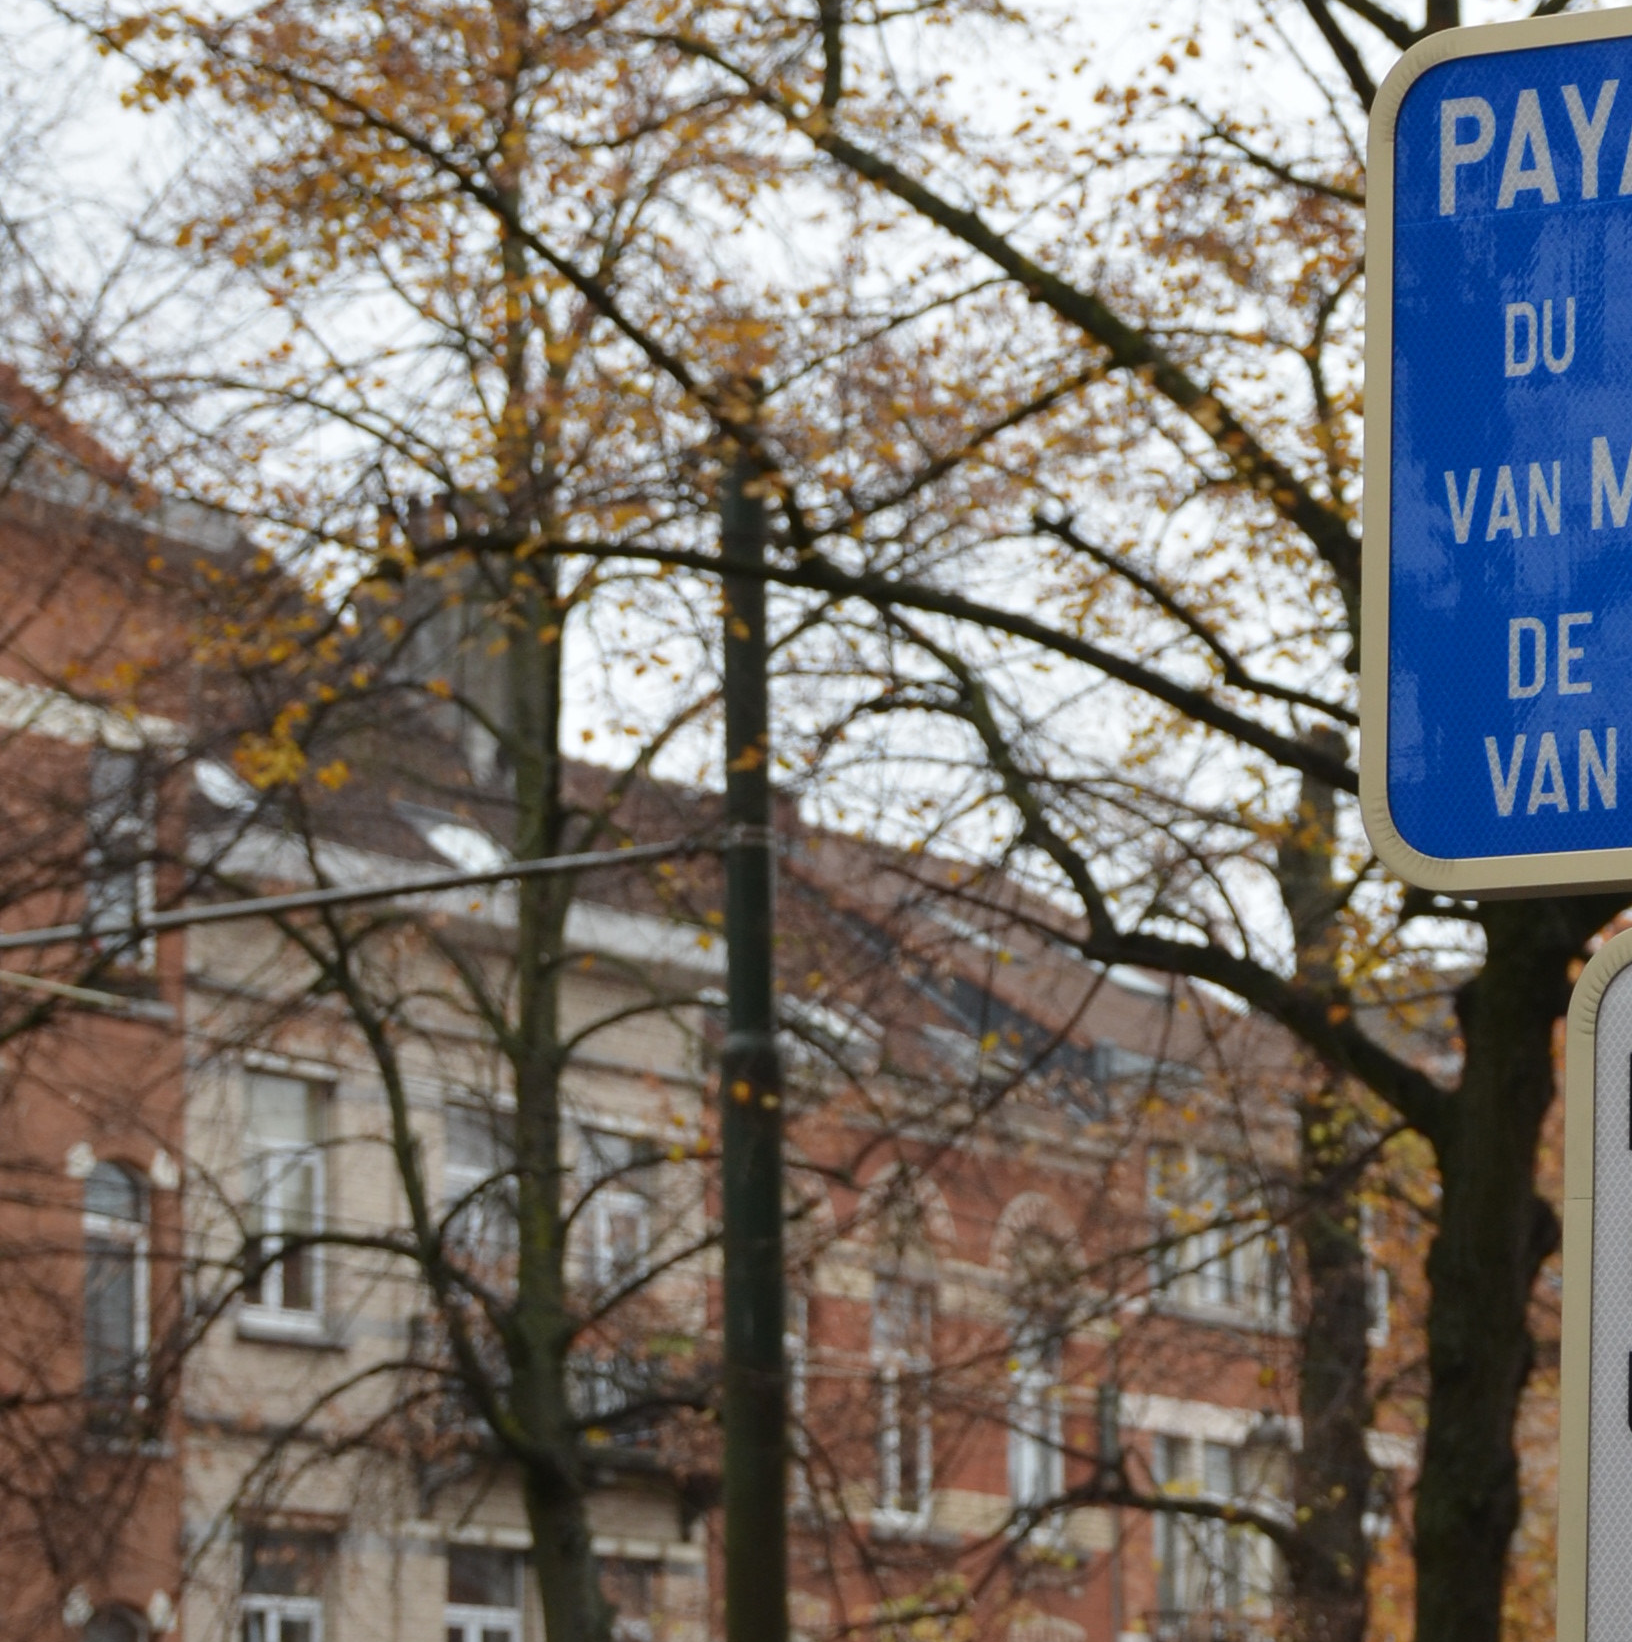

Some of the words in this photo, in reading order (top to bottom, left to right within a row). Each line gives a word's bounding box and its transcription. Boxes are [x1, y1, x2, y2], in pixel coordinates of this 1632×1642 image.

[1505, 297, 1576, 377] DU
[1445, 461, 1562, 544] VAN
[1508, 612, 1593, 699] DE
[1485, 727, 1618, 816] VAN
